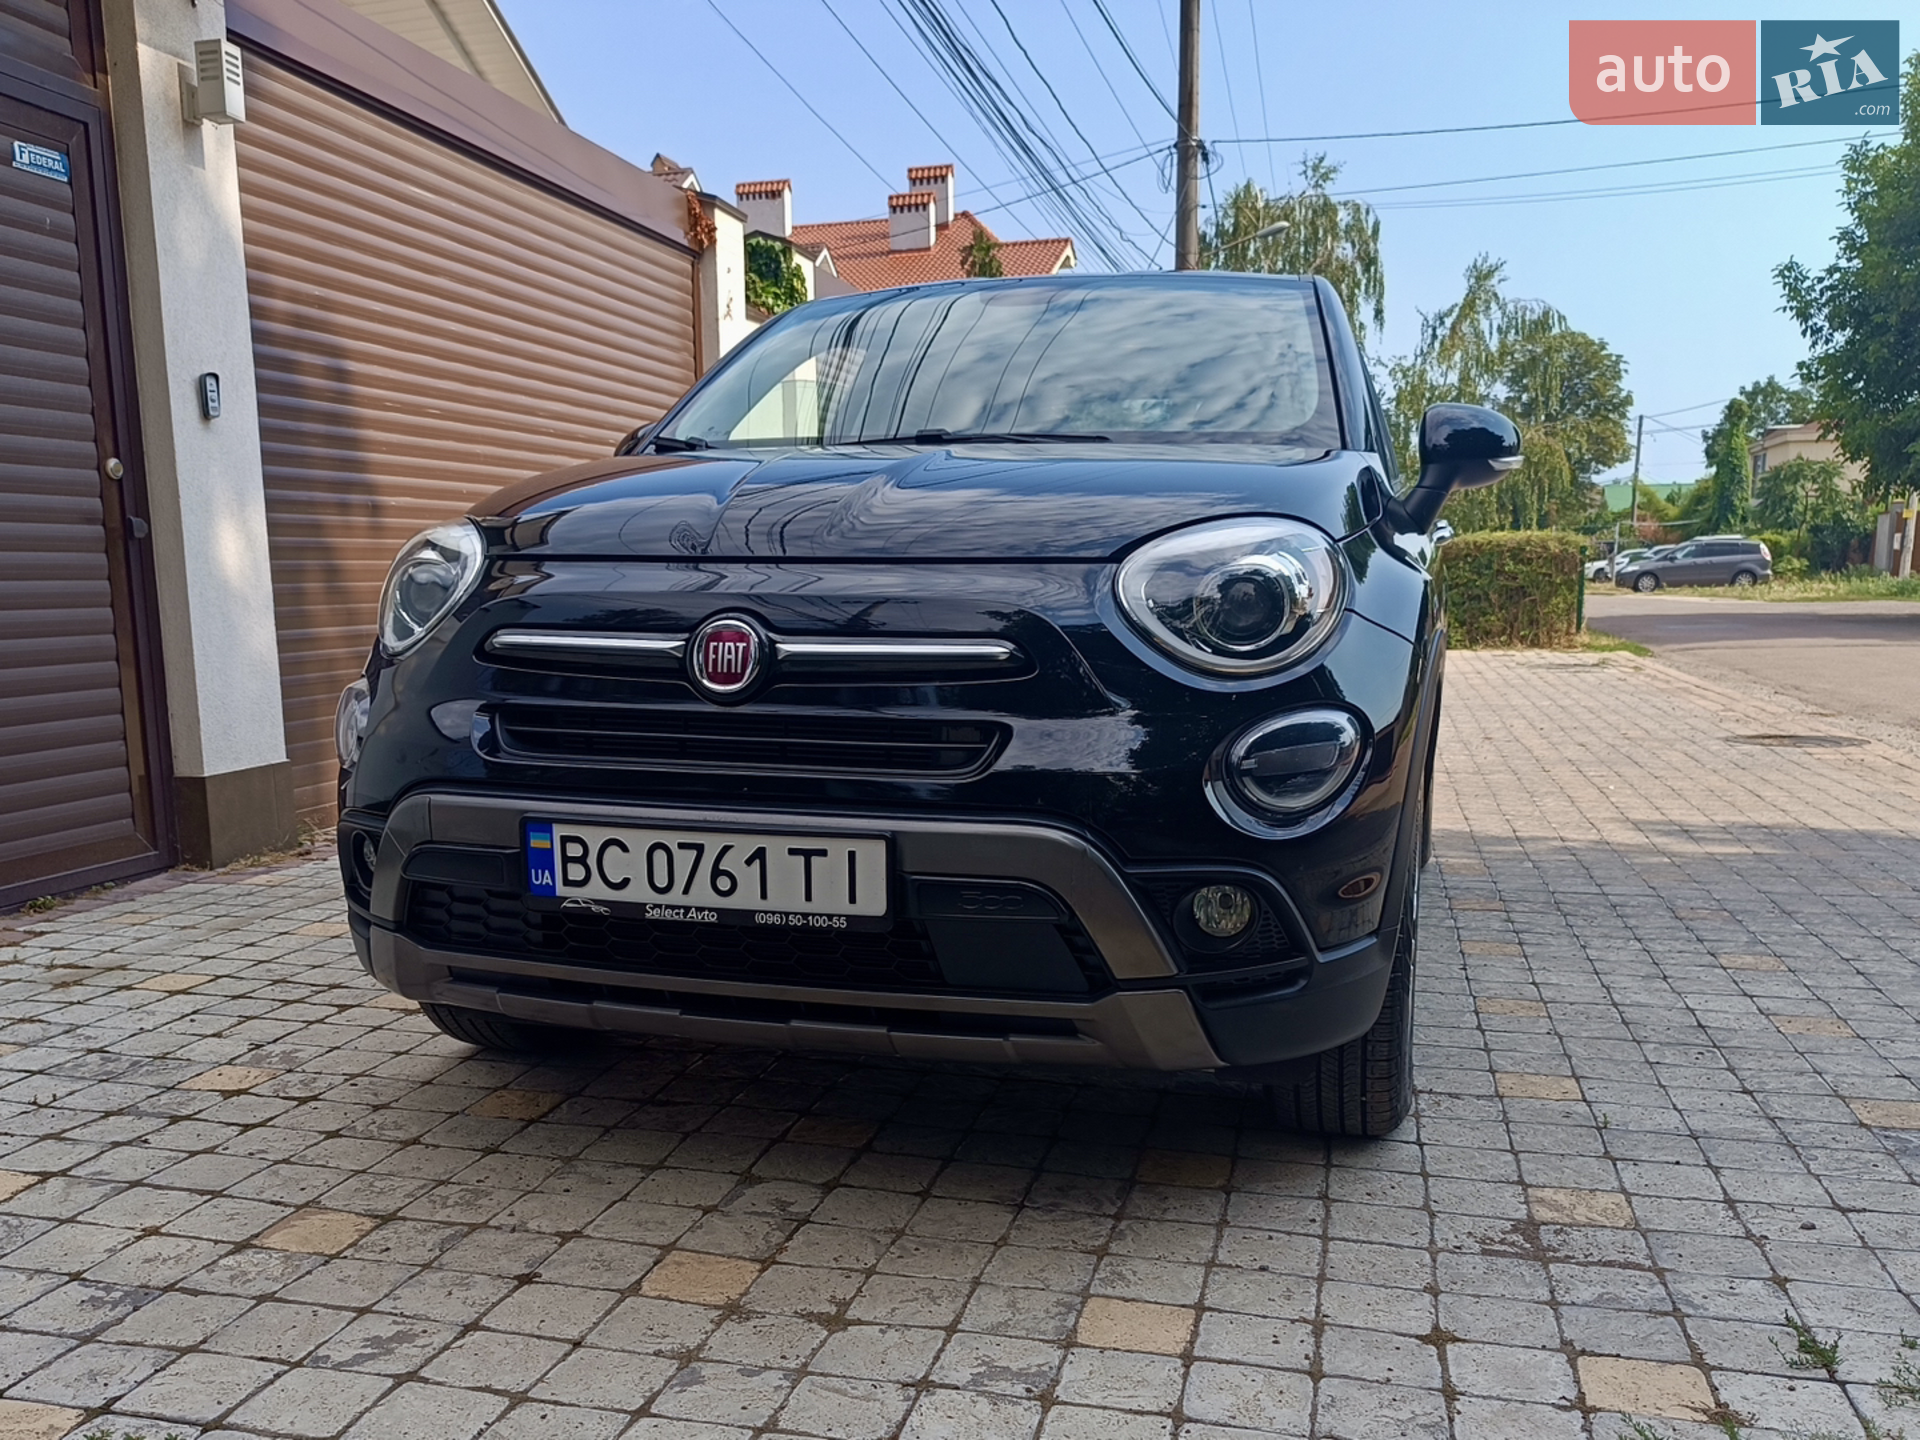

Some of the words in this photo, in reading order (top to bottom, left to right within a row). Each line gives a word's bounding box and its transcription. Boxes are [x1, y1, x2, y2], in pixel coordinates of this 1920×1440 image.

[13, 140, 66, 173] FEDERAL
[708, 641, 748, 673] FIAT
[531, 868, 553, 886] UA
[559, 834, 631, 890] BC
[646, 841, 768, 900] 0761
[787, 847, 857, 905] TI
[645, 903, 685, 919] Select
[755, 911, 786, 926] (096)
[788, 914, 847, 929] 50-100-55
